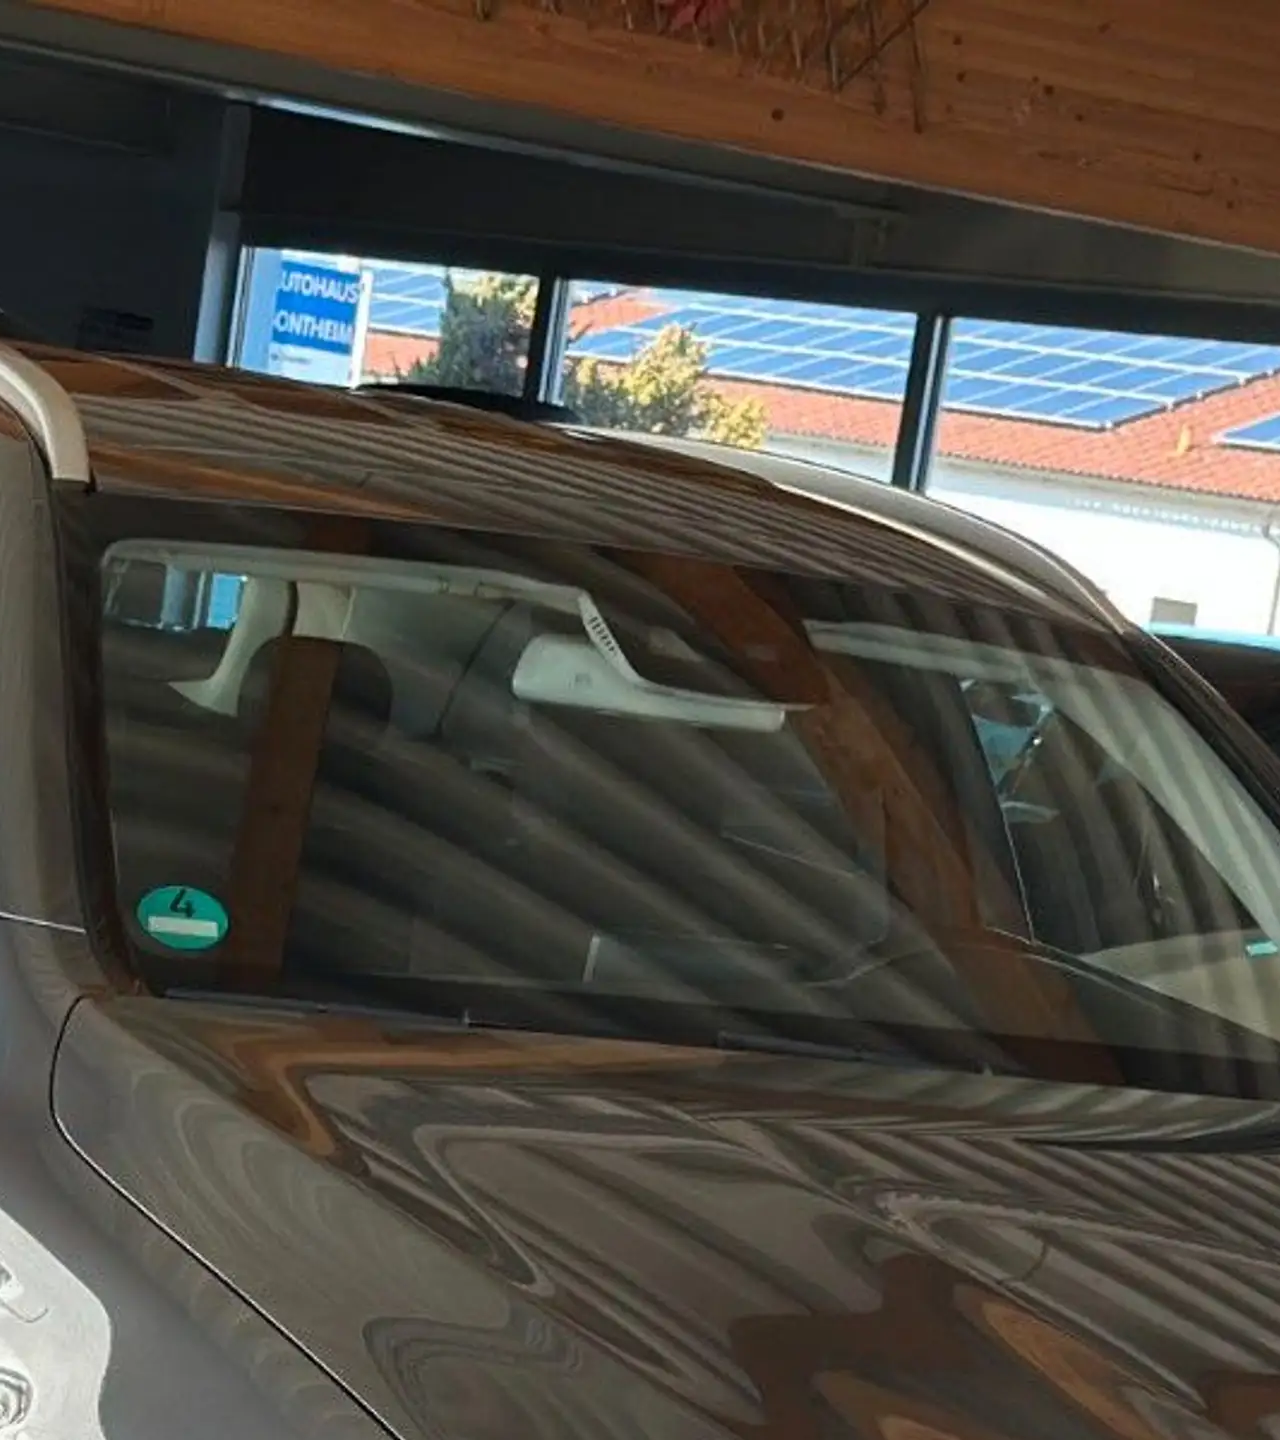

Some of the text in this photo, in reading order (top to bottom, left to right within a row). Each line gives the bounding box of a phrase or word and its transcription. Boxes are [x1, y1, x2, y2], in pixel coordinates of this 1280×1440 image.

[277, 270, 358, 303] UTOHAUS
[273, 309, 353, 345] ONTHEIM
[169, 888, 196, 918] 4
